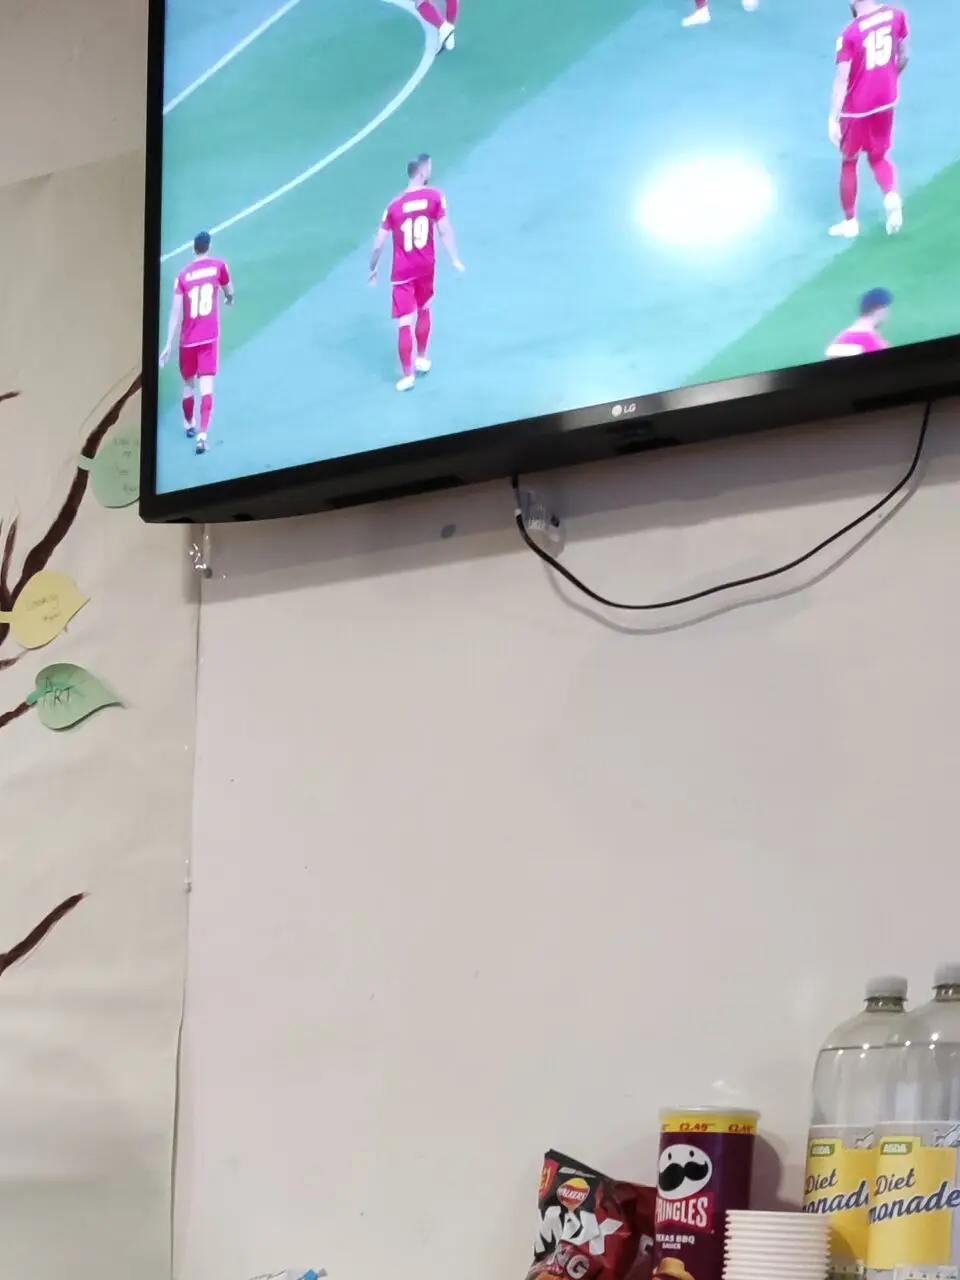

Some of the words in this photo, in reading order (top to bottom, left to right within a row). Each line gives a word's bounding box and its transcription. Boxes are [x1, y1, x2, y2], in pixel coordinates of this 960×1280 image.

[862, 25, 893, 71] 15
[401, 215, 429, 252] 19
[623, 403, 637, 414] LG
[43, 676, 75, 707] ART
[804, 1168, 839, 1196] Diet
[874, 1167, 916, 1197] Diet
[656, 1197, 709, 1228] RINGLES
[676, 1233, 695, 1245] BBQ
